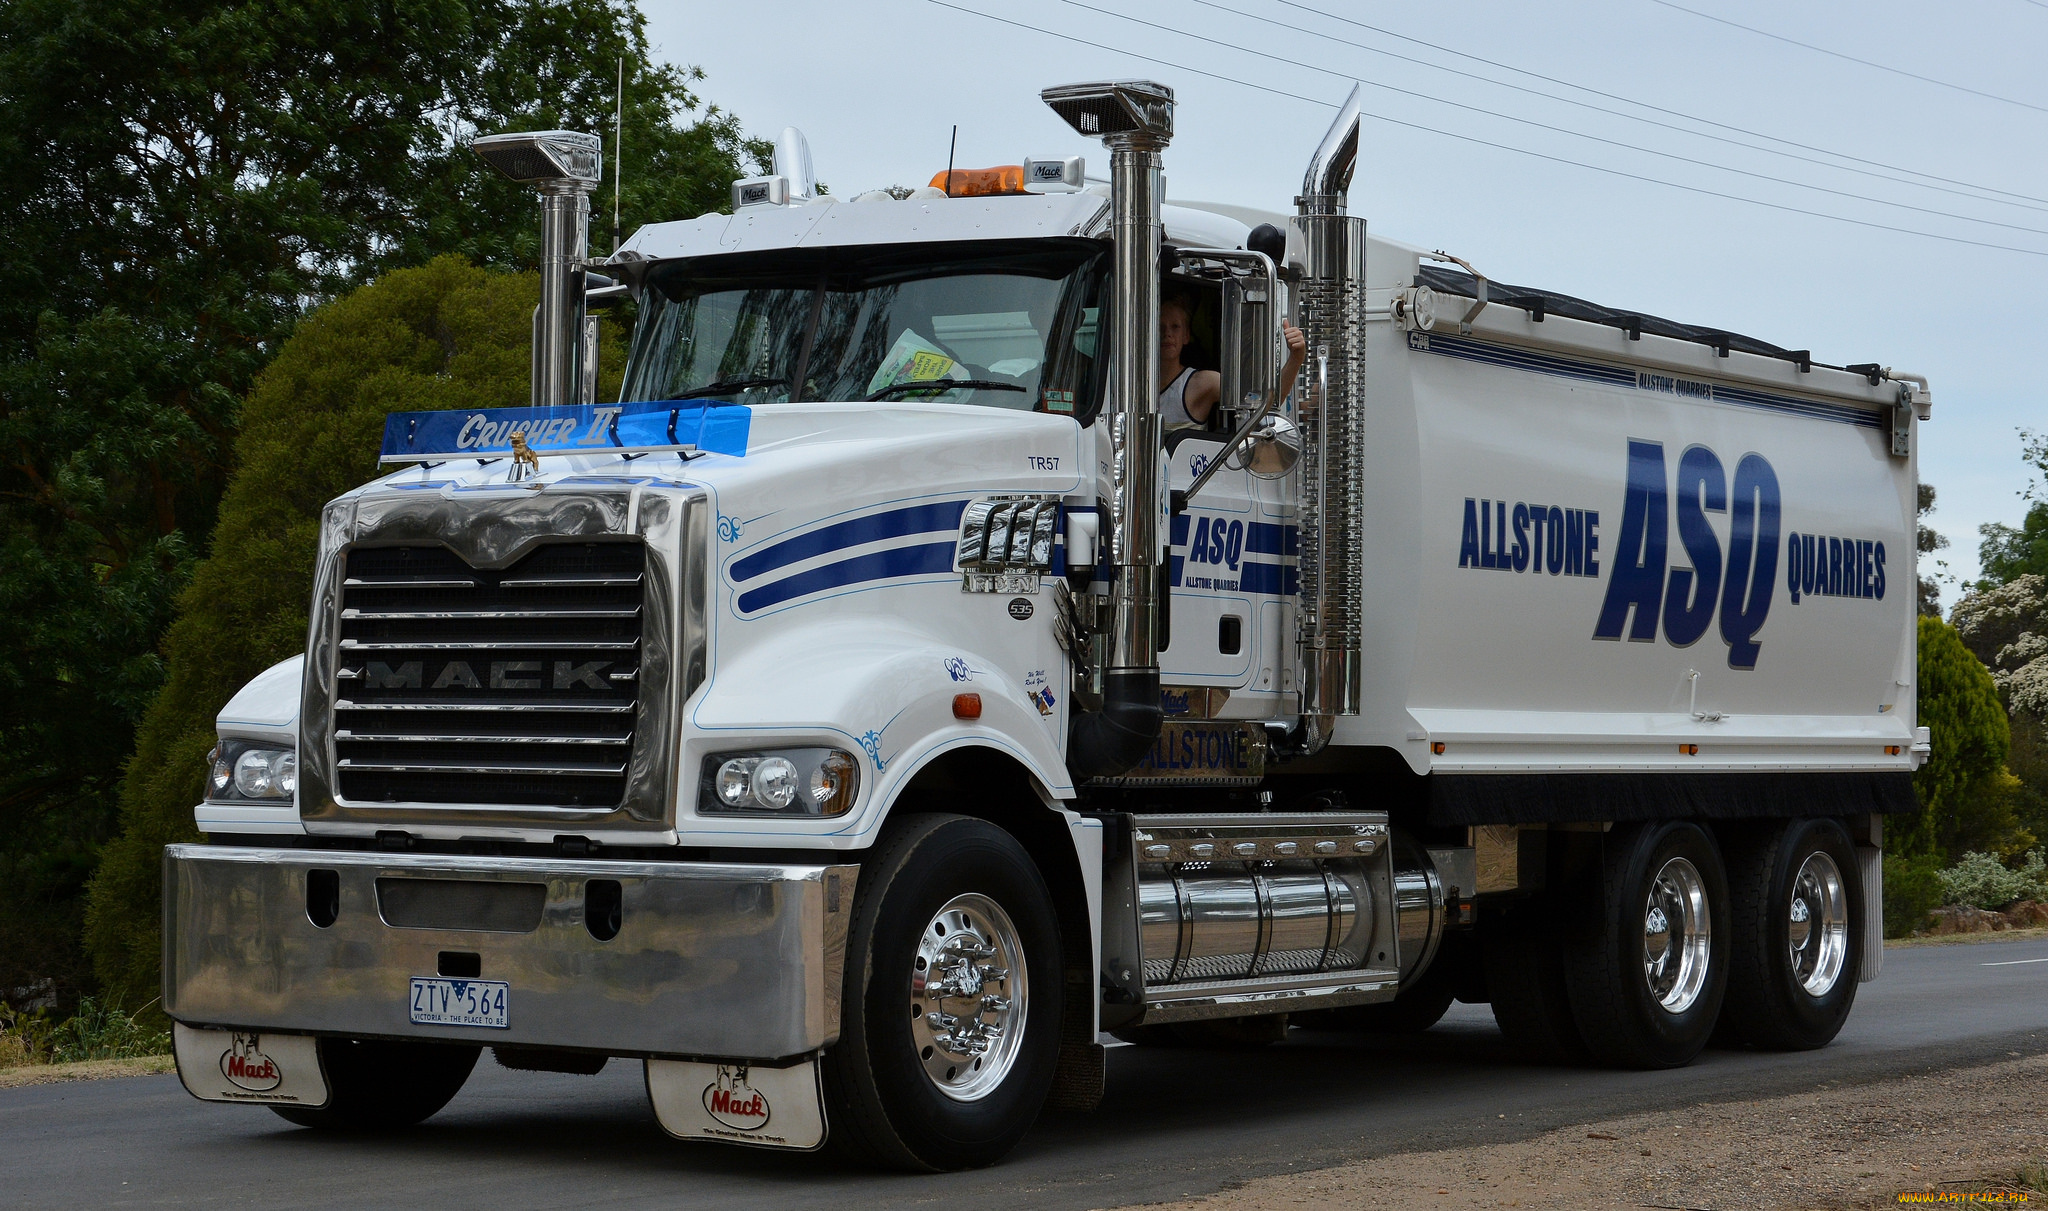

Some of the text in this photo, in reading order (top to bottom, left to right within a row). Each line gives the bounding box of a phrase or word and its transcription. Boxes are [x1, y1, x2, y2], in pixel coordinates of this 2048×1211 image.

[1034, 166, 1062, 179] Mack
[742, 187, 767, 201] Mack
[1638, 373, 1711, 400] ALLSTONE QUARRIES
[1028, 456, 1060, 471] TR57
[1190, 516, 1244, 571] ASQ
[1458, 436, 1887, 672] ALLSTONE ASQ QUARRIES
[1186, 576, 1239, 592] ALLSTONE QUARRIES
[1010, 604, 1032, 614] 535
[364, 661, 615, 690] MACK
[414, 984, 505, 1017] ZTV 564
[464, 1016, 482, 1024] PLACE
[485, 1017, 493, 1025] TO
[227, 1055, 279, 1080] Mack
[711, 1090, 766, 1117] Mack
